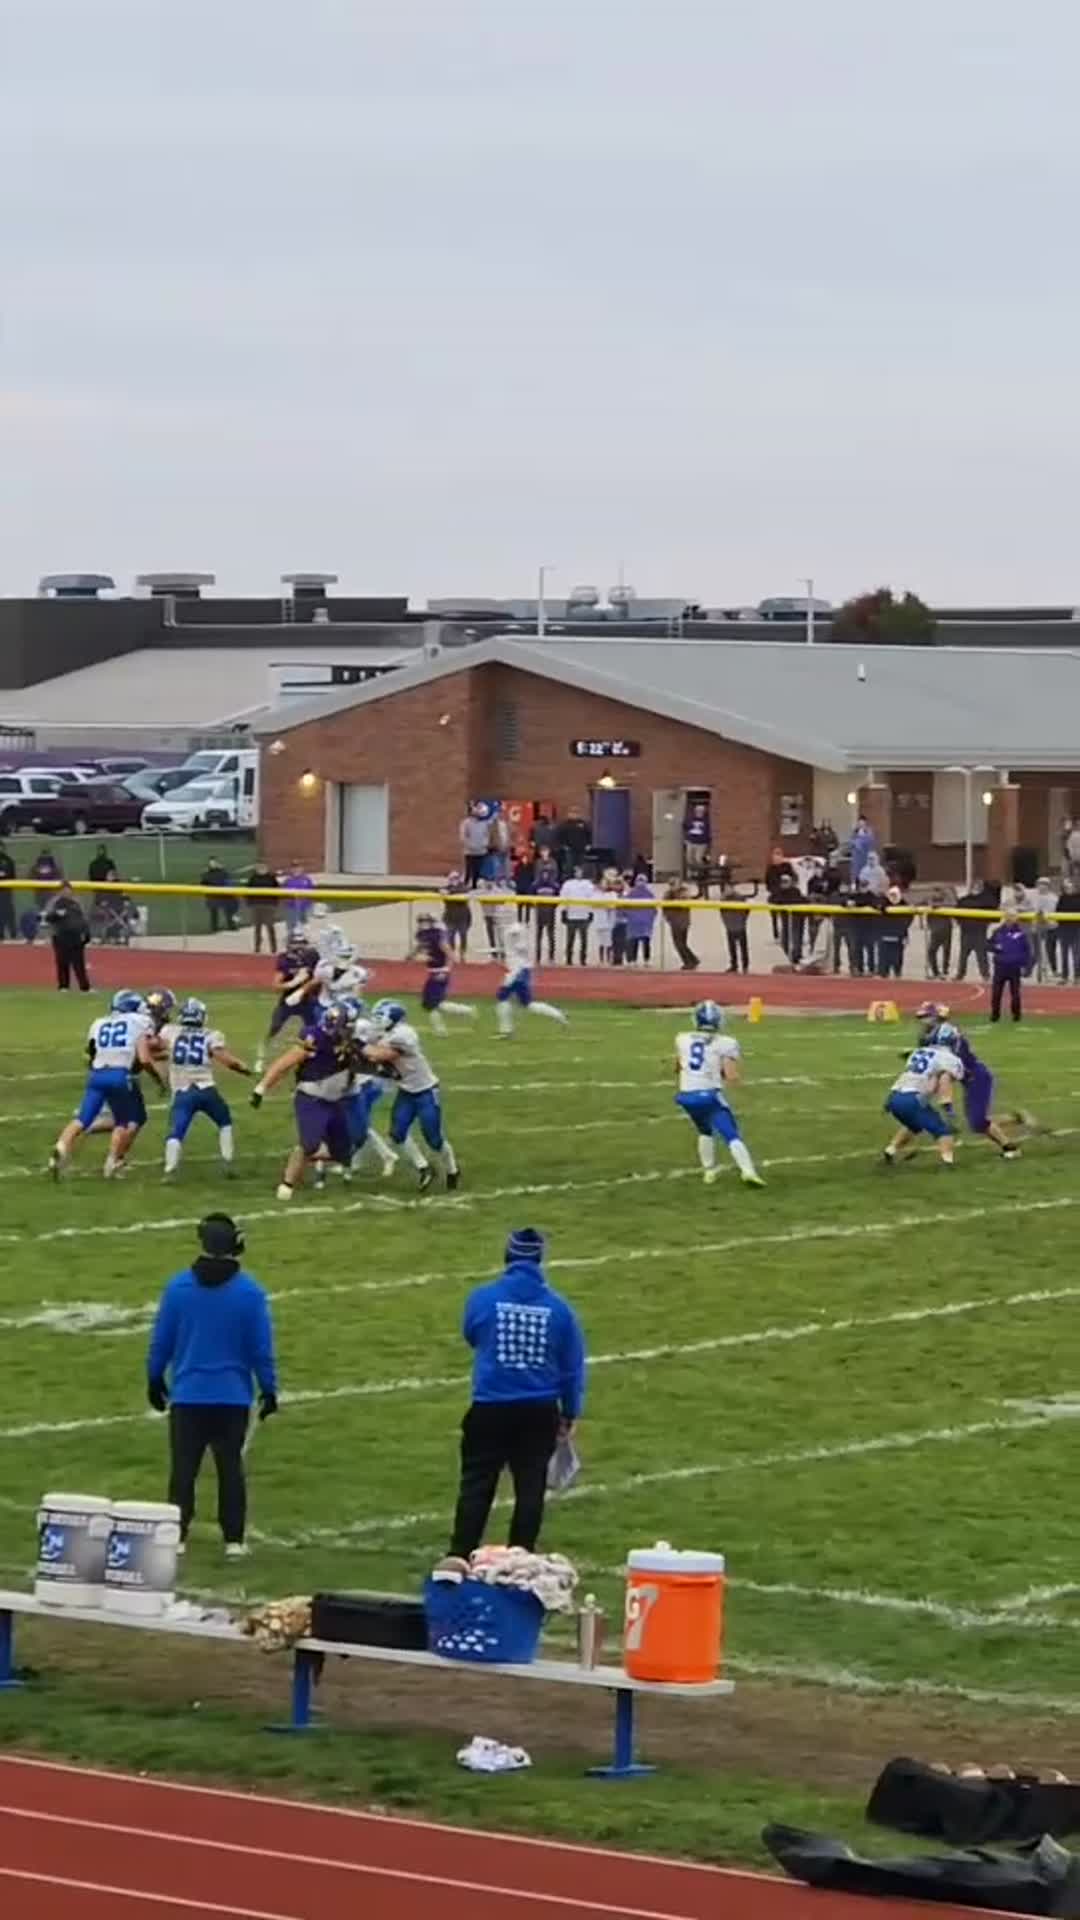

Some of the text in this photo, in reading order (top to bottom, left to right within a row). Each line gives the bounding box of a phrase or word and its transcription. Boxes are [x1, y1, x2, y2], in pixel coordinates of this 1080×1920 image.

[98, 1020, 128, 1048] 62
[172, 1034, 205, 1065] 65
[689, 1041, 705, 1071] 9
